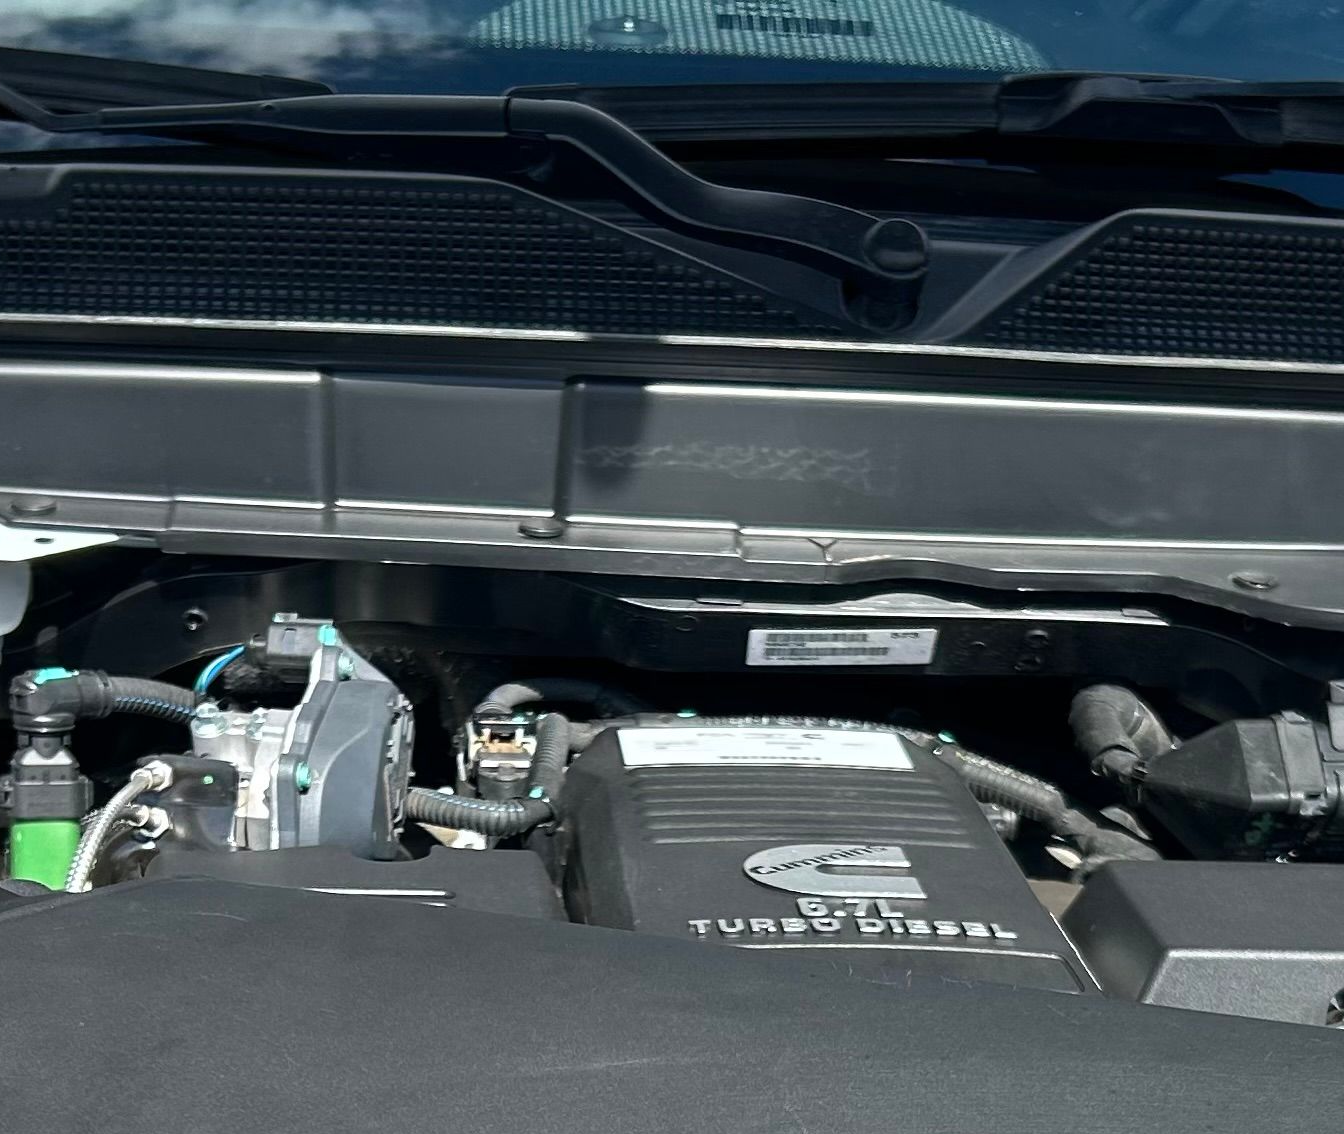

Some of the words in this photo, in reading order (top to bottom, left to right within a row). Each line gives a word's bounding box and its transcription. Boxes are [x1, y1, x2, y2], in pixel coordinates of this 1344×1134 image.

[750, 845, 888, 875] Cummins
[796, 897, 905, 918] 6.7L
[688, 917, 841, 934] TURBO
[856, 918, 1018, 939] DIESEL
